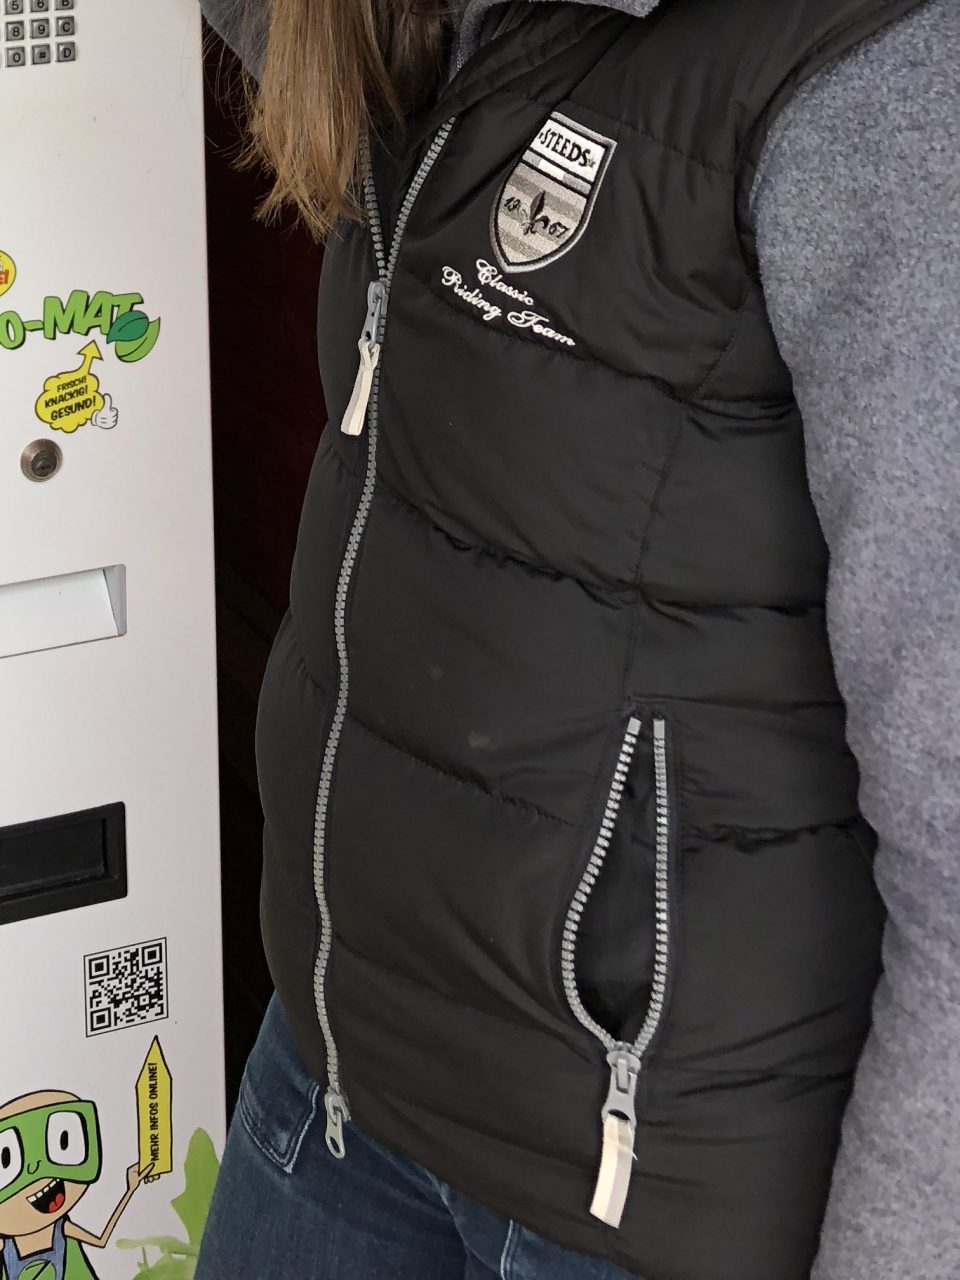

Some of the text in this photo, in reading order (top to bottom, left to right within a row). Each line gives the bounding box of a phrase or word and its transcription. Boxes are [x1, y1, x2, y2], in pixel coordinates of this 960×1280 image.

[12, 1, 19, 11] 5
[13, 27, 20, 37] 8
[38, 24, 45, 34] 9
[63, 22, 70, 32] C
[64, 47, 71, 58] D
[539, 129, 591, 167] STEEDS
[549, 223, 569, 239] 67
[476, 258, 534, 306] Classic
[441, 265, 575, 346] Riding Team
[57, 375, 86, 392] FRISCH!
[45, 385, 88, 408] KNACKIG!
[51, 395, 96, 421] GESUND!
[148, 1063, 159, 1162] MEHR INFOS ONLINE!
